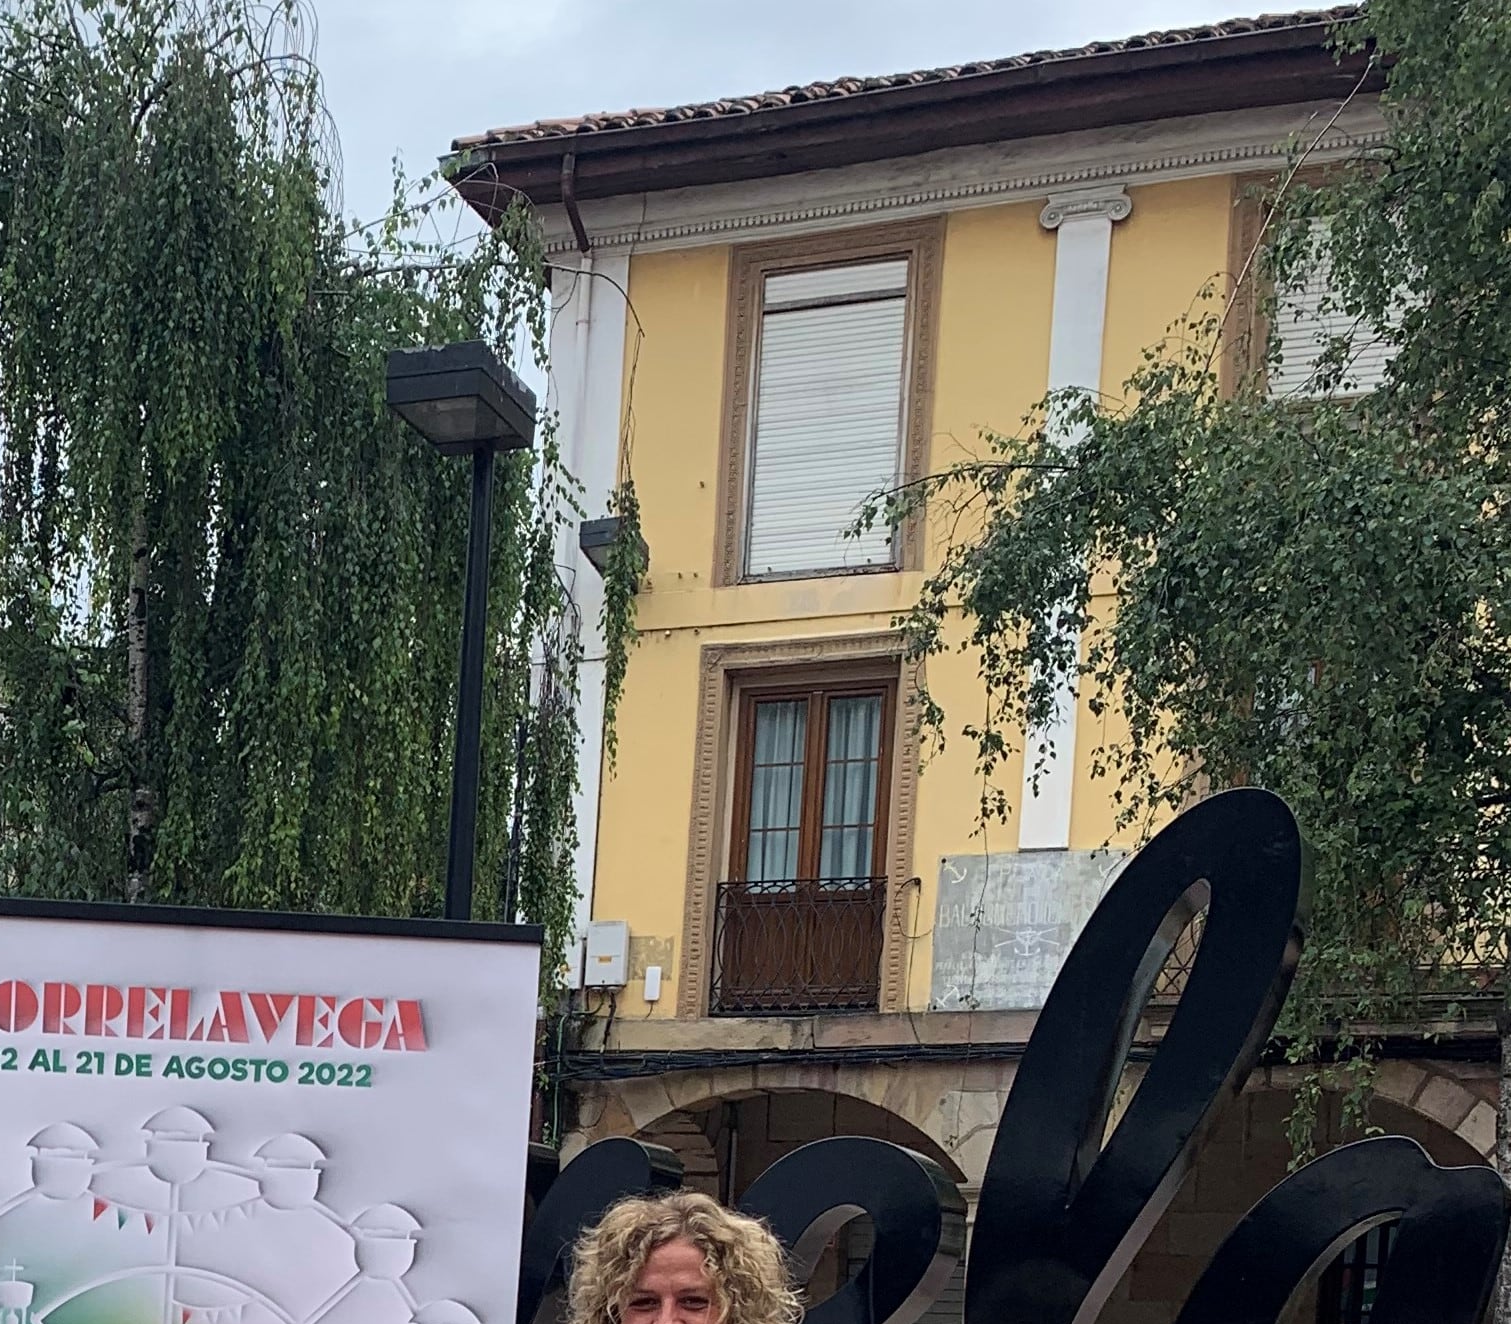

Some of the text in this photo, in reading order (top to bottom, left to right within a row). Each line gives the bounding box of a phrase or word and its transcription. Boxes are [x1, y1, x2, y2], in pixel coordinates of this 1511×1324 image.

[29, 1048, 67, 1074] AL
[76, 1051, 106, 1075] 21
[115, 1053, 153, 1078] DE
[162, 1056, 290, 1084] AGOSTO
[298, 1061, 373, 1088] 2022
